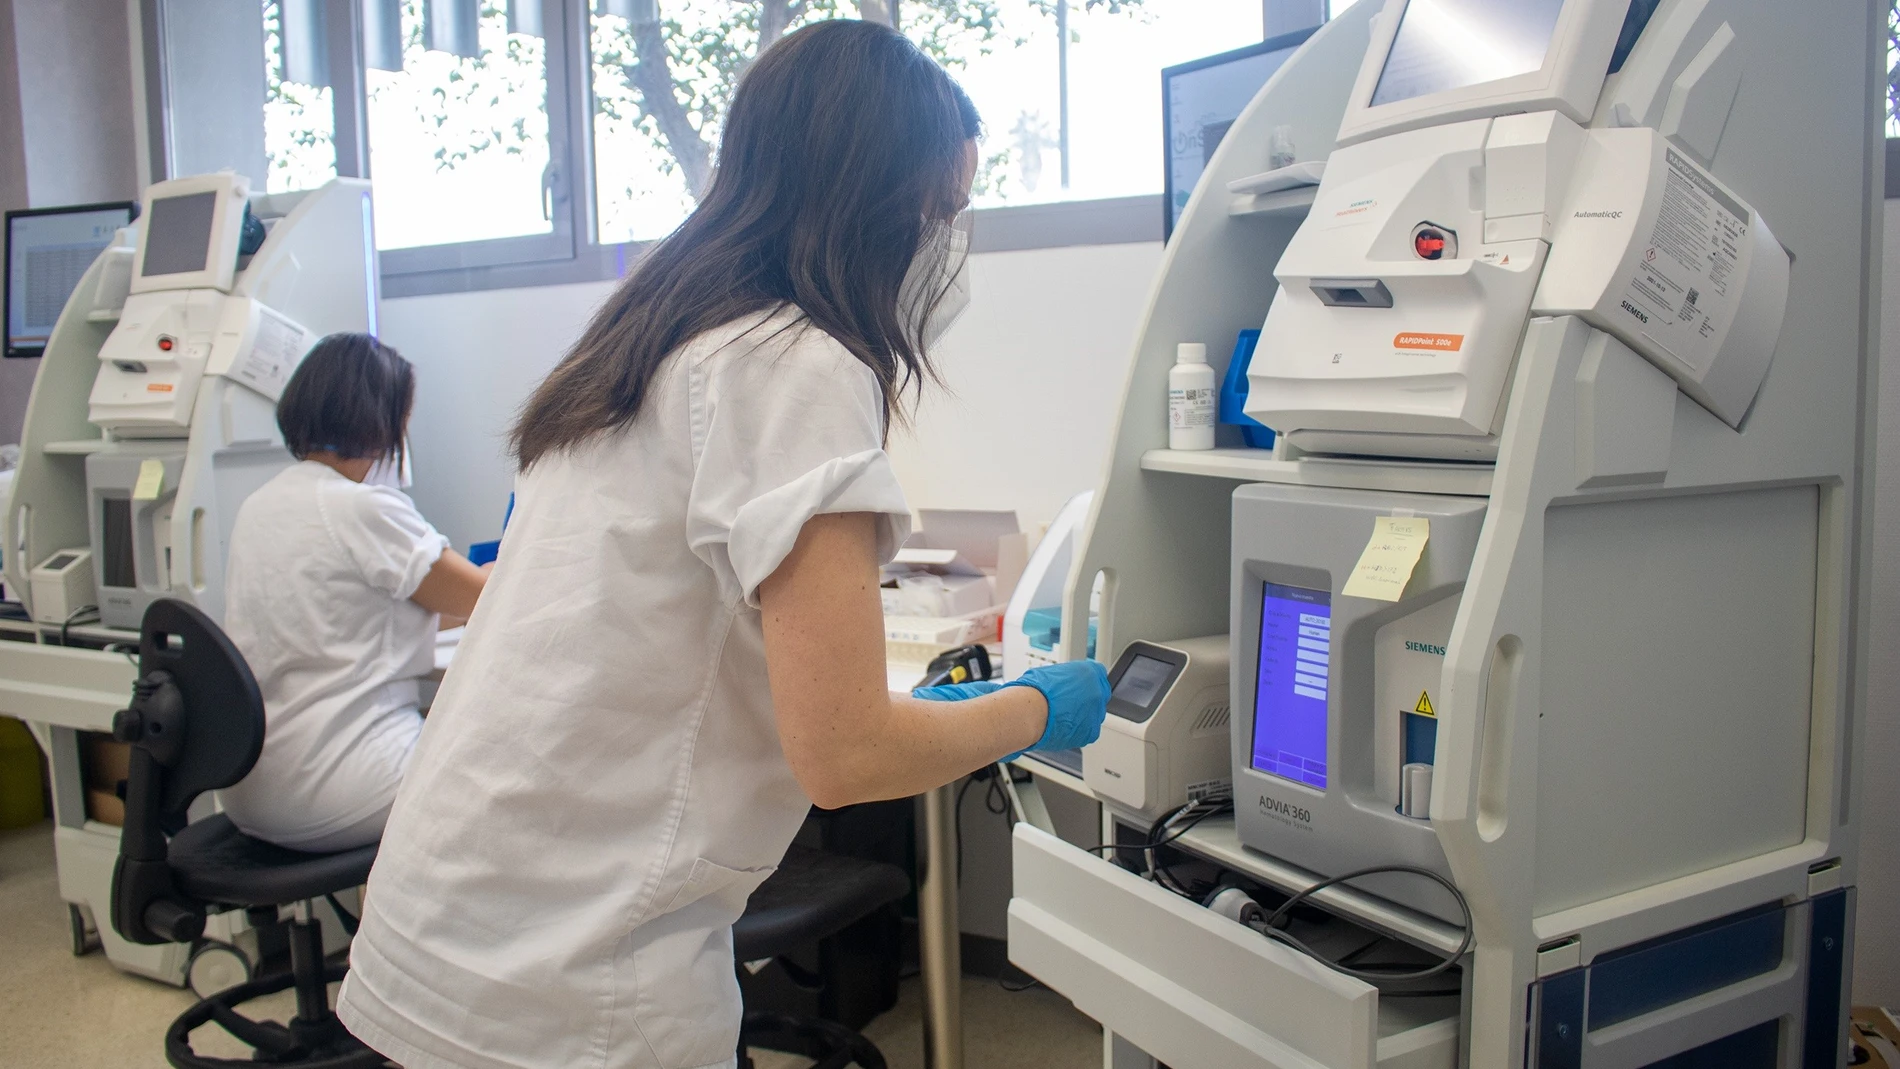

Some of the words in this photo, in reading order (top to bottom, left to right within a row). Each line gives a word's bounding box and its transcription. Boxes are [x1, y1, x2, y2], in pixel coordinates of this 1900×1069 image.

[1669, 153, 1715, 195] RAPIDSystems
[1573, 210, 1623, 219] AutomaticQC
[1620, 299, 1649, 324] SIEMENS
[1399, 336, 1434, 345] RAPIDPoint
[1405, 640, 1446, 656] SIEMENS
